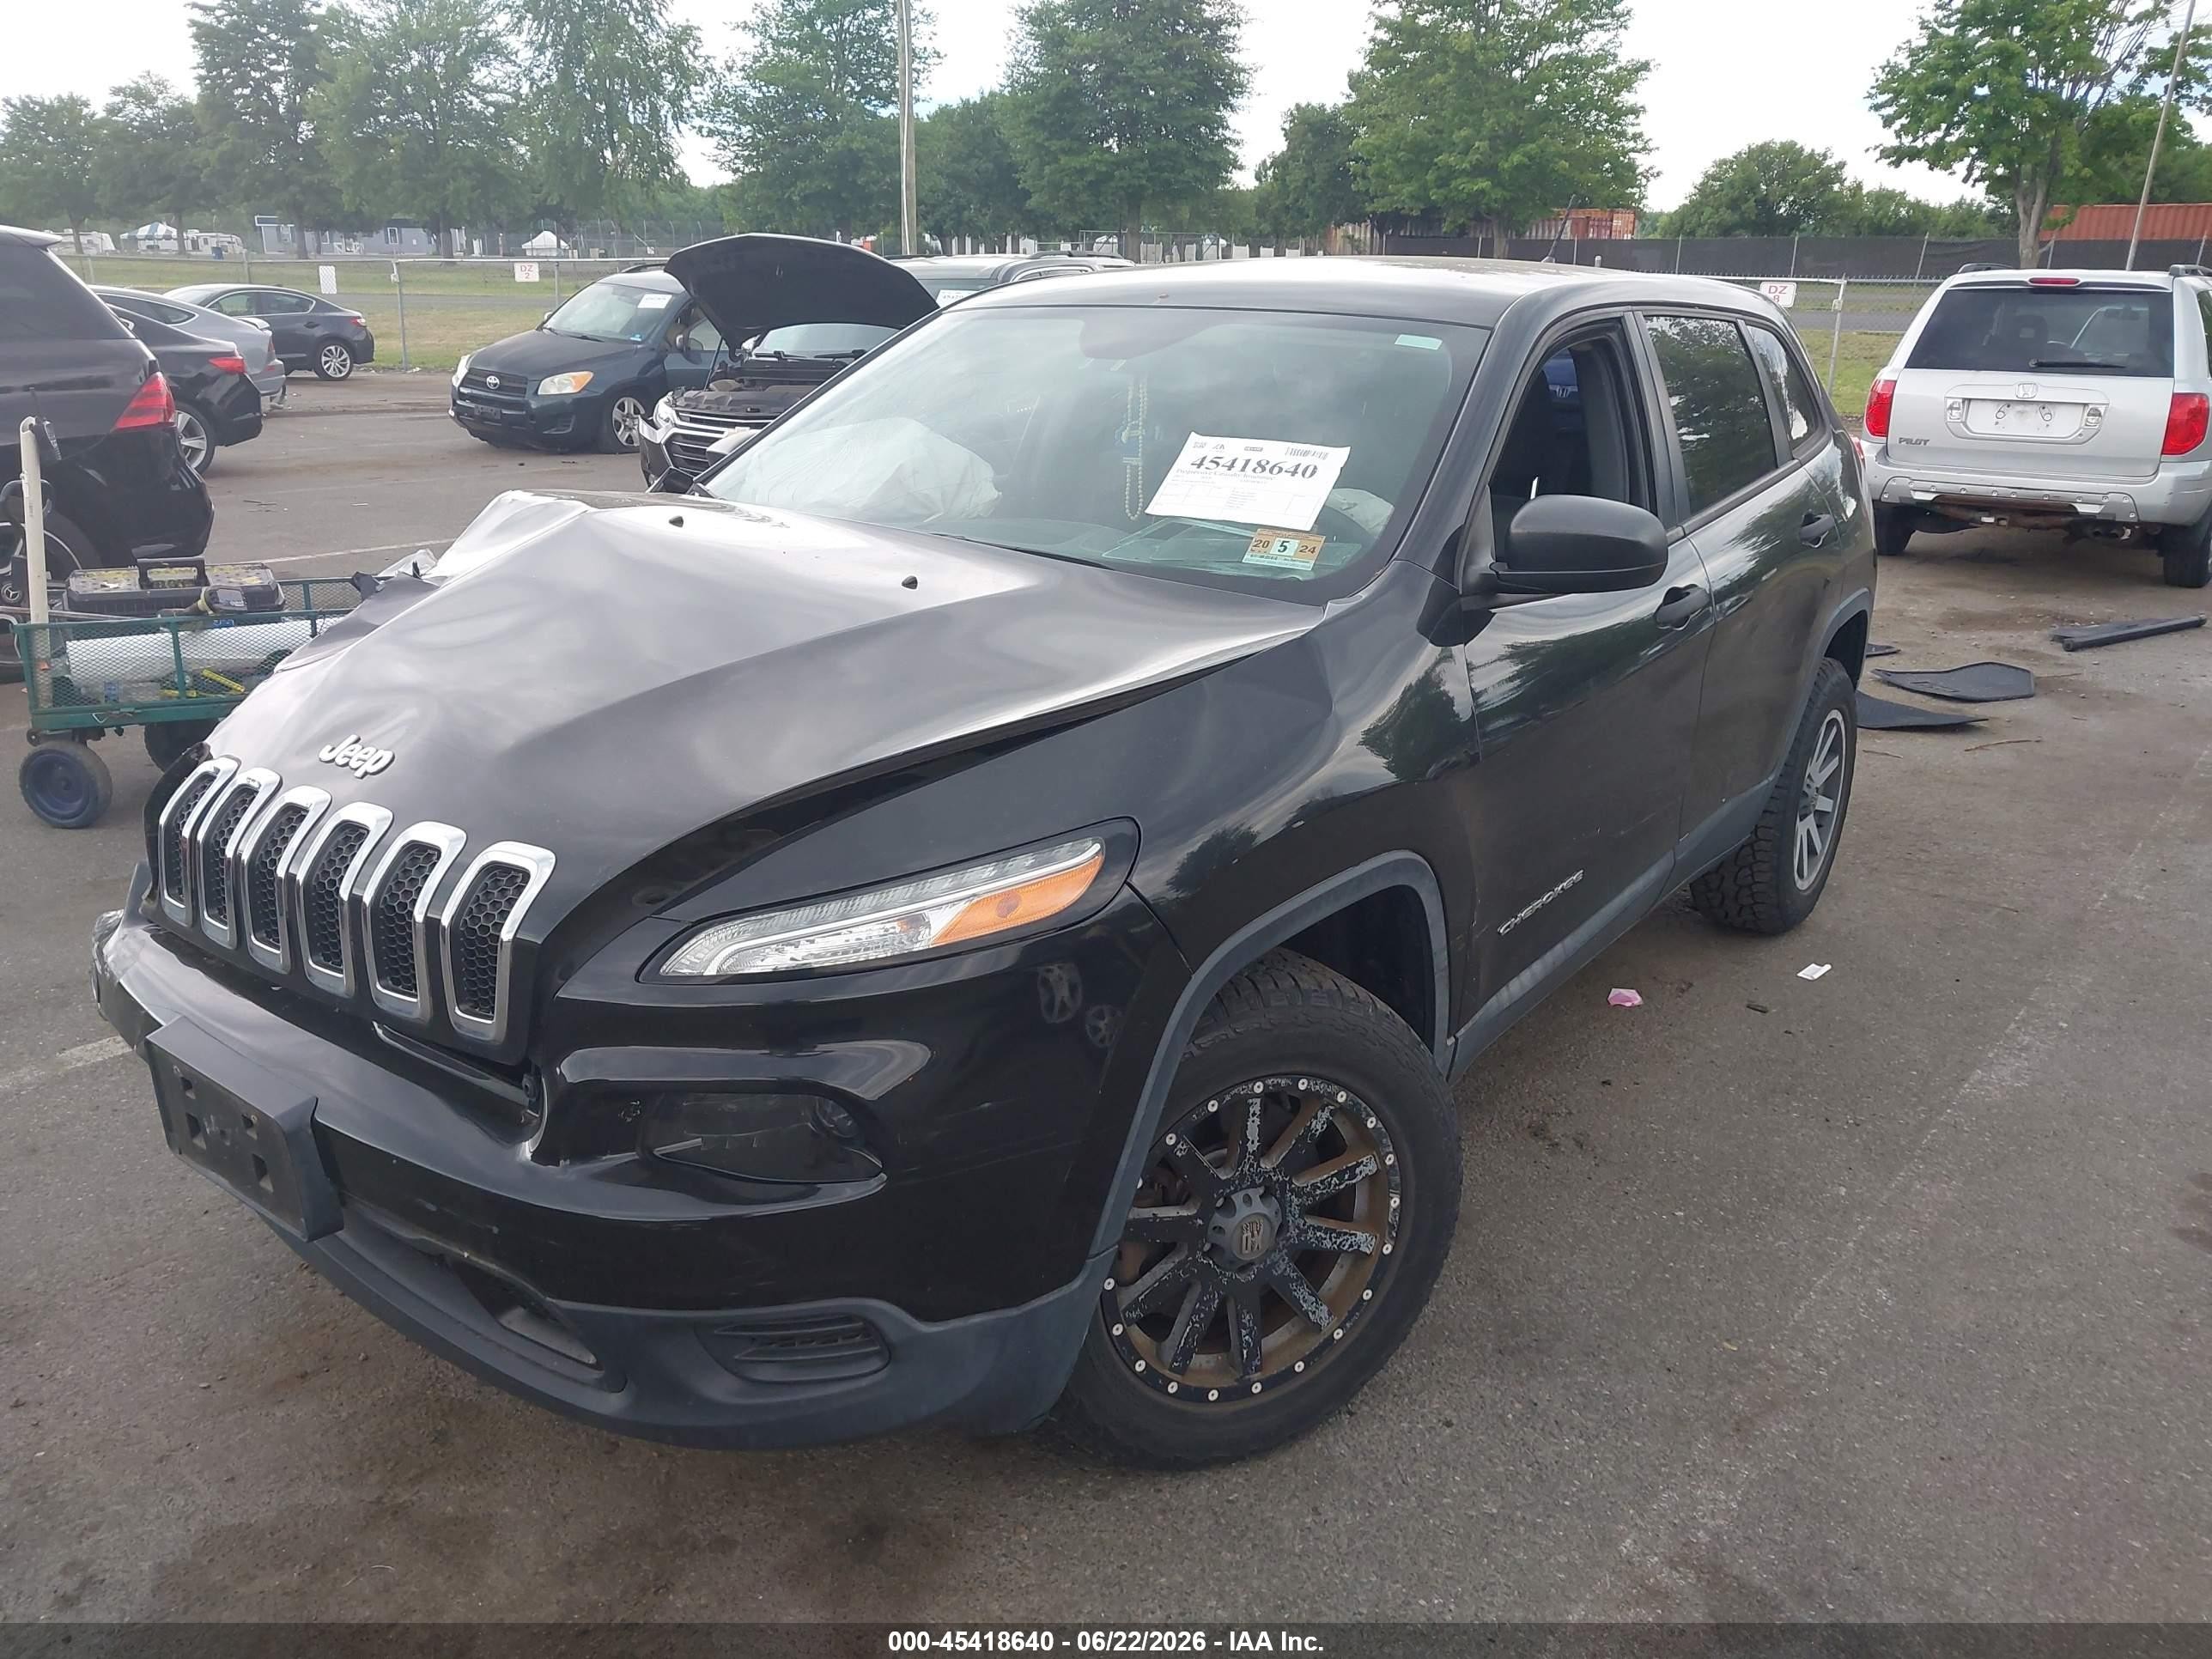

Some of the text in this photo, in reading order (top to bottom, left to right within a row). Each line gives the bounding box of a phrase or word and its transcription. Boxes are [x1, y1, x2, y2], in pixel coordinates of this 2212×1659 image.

[1768, 285, 1788, 295] DZ
[1899, 437, 1929, 446] PILOT
[1190, 454, 1319, 479] 45418640
[1252, 539, 1270, 549] 20
[1277, 540, 1290, 553] 5
[1298, 544, 1316, 554] 24
[319, 734, 395, 779] Jeep
[1497, 869, 1584, 936] CHEROKEE
